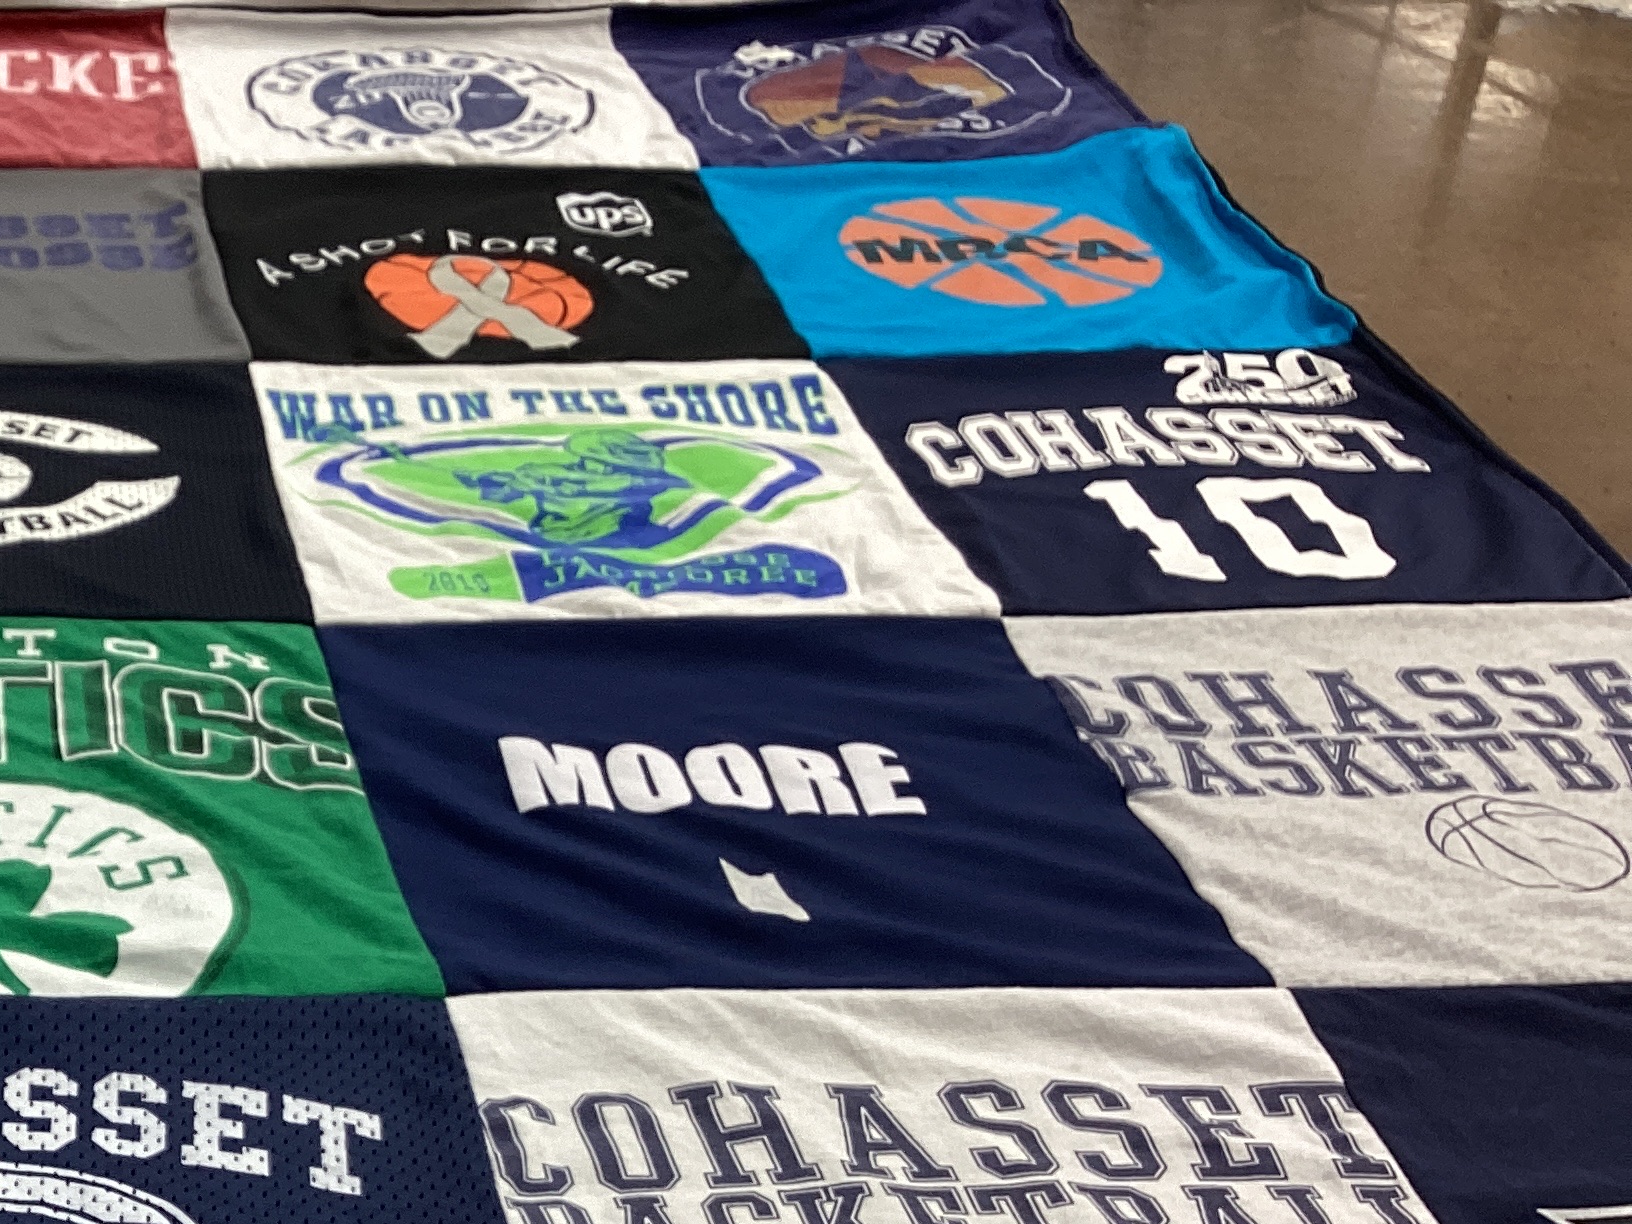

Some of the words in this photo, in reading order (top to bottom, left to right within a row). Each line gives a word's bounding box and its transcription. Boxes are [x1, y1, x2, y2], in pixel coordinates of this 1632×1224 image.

[255, 257, 292, 288] A
[289, 229, 426, 273] SHOT
[447, 229, 560, 255] FOR
[572, 245, 690, 289] LIFE
[266, 389, 403, 441] WAR
[421, 390, 491, 422] ON
[511, 382, 628, 415] THE
[641, 374, 839, 436] SHORE
[905, 406, 1431, 486] COHASSET
[1084, 477, 1397, 581] 10
[497, 735, 927, 816] MOORE
[478, 1080, 1394, 1197] COHASSET
